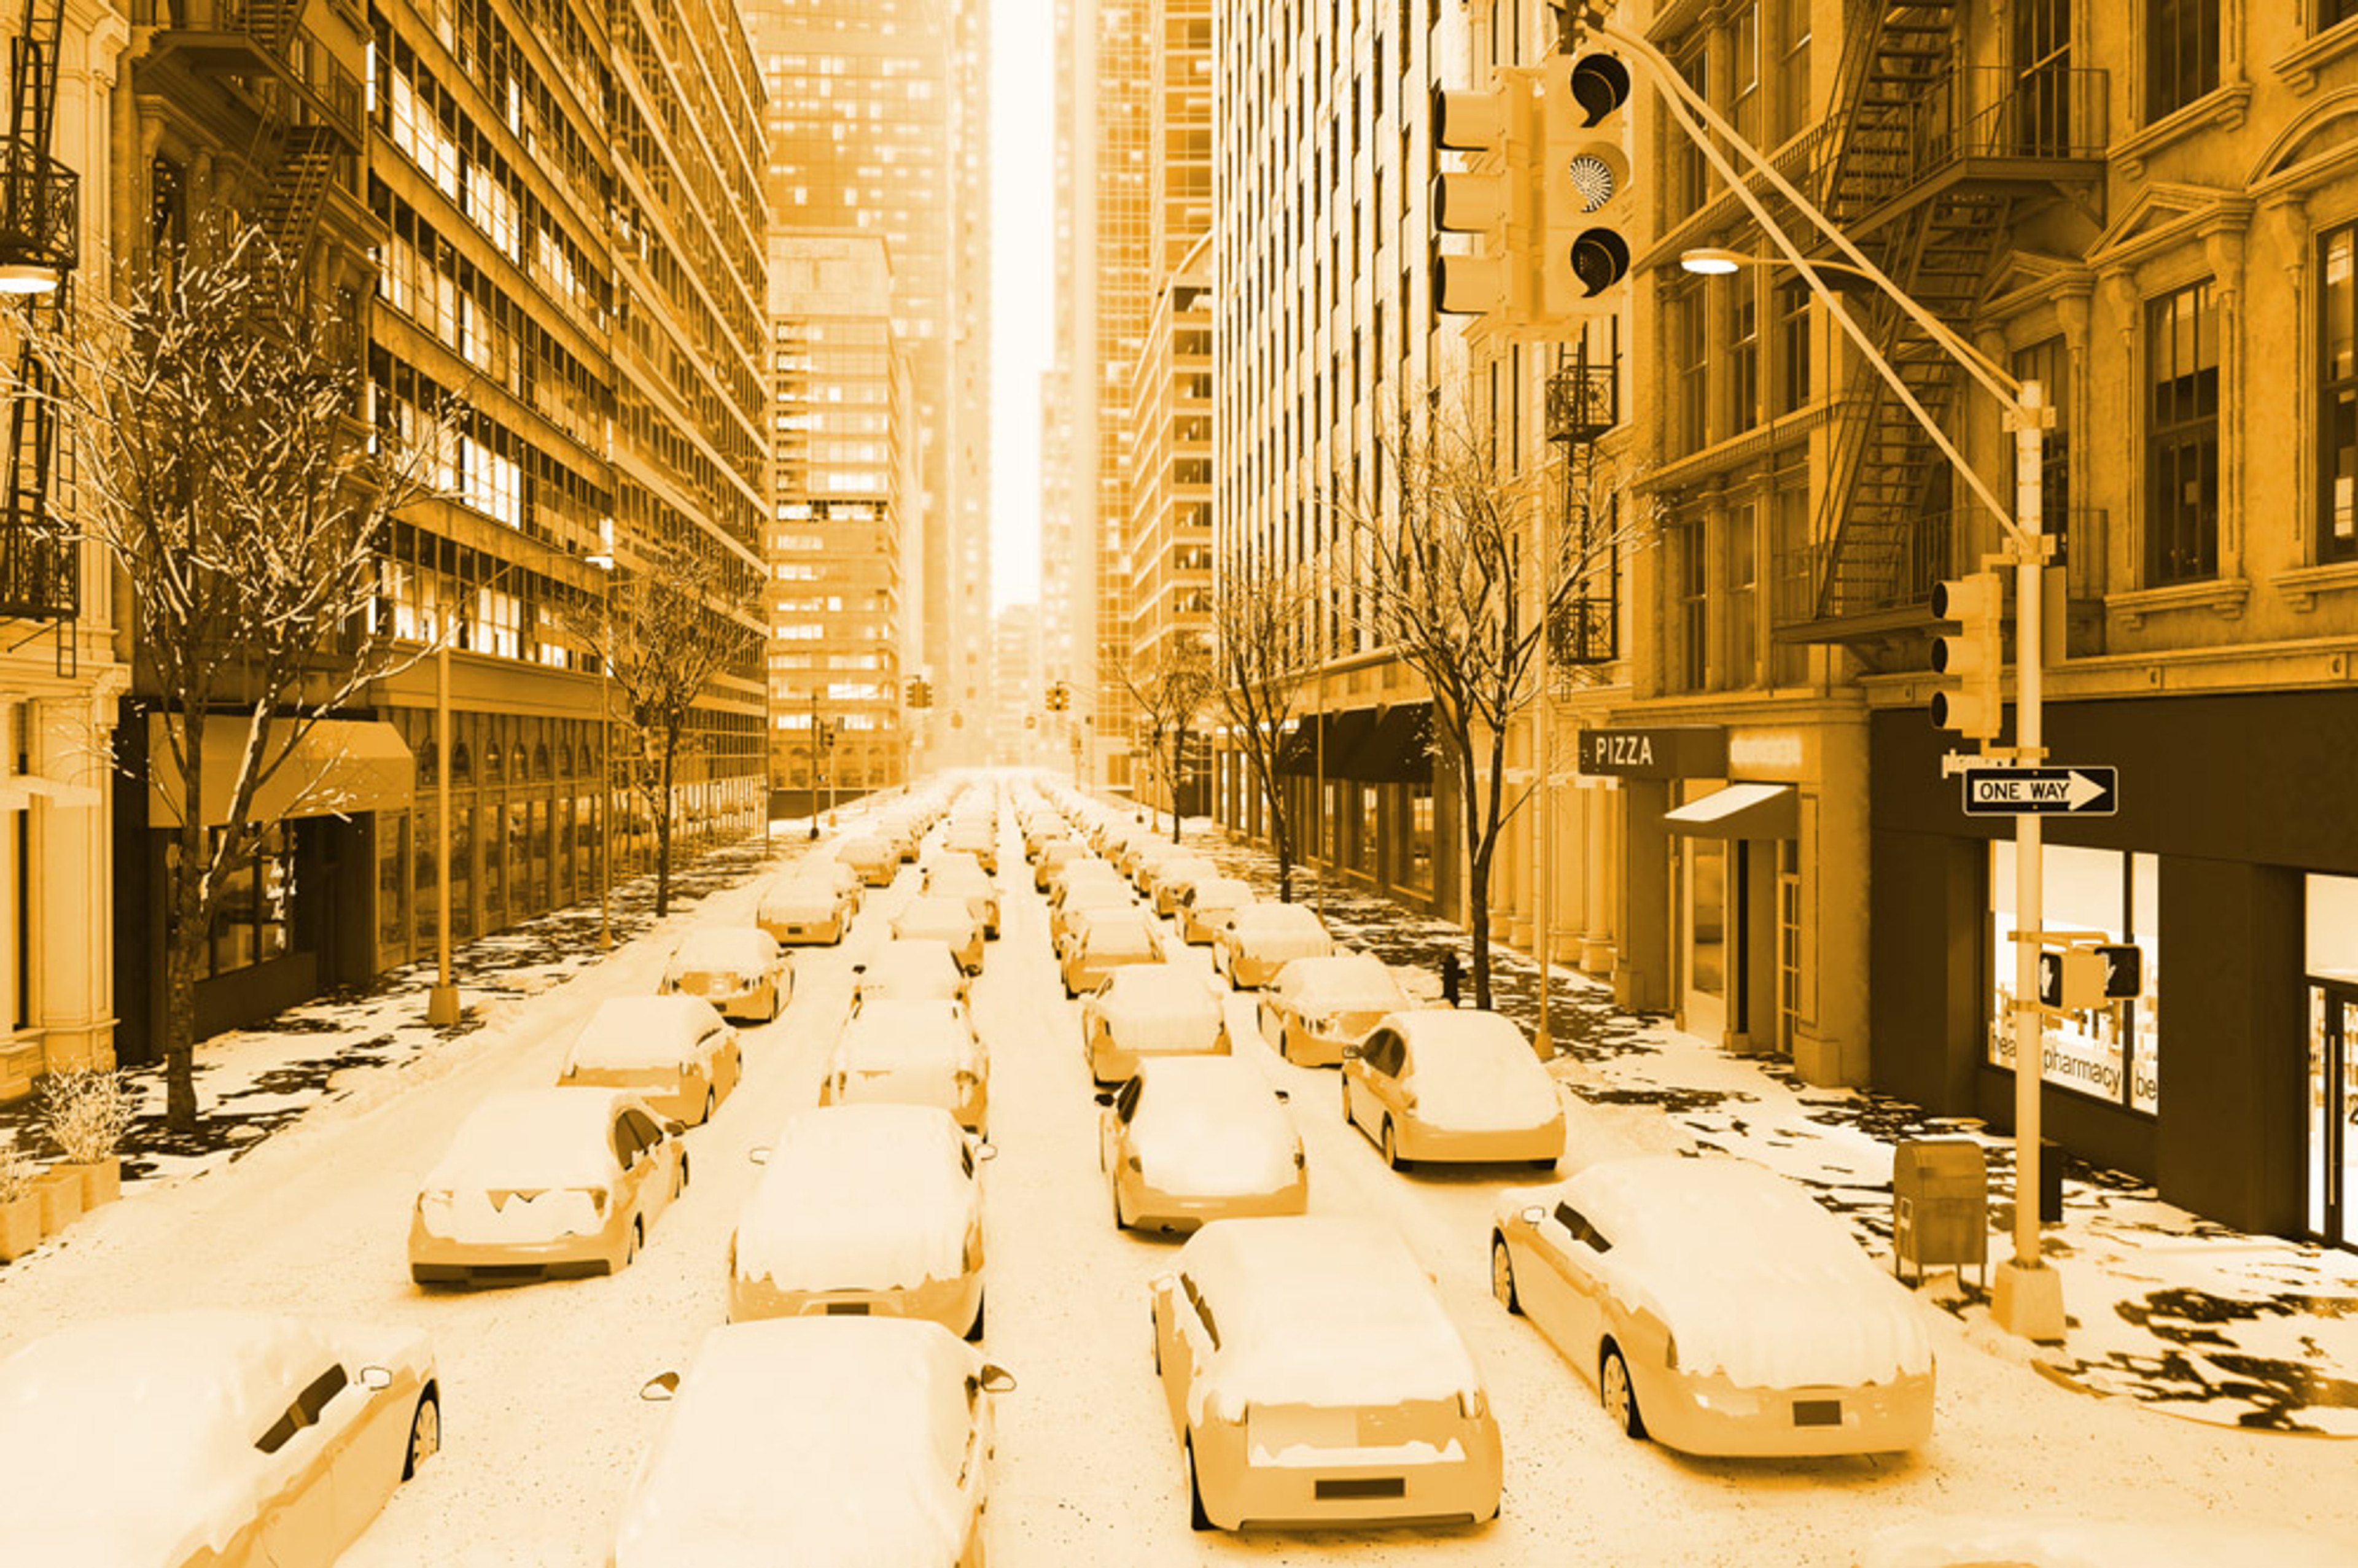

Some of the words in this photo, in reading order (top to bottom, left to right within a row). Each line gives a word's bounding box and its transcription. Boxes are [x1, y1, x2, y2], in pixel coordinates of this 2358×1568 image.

[1596, 736, 1653, 765] PIZZA
[1980, 783, 2020, 800] ONE
[2031, 783, 2069, 799] WAY
[2044, 1045, 2120, 1096] pharmacy
